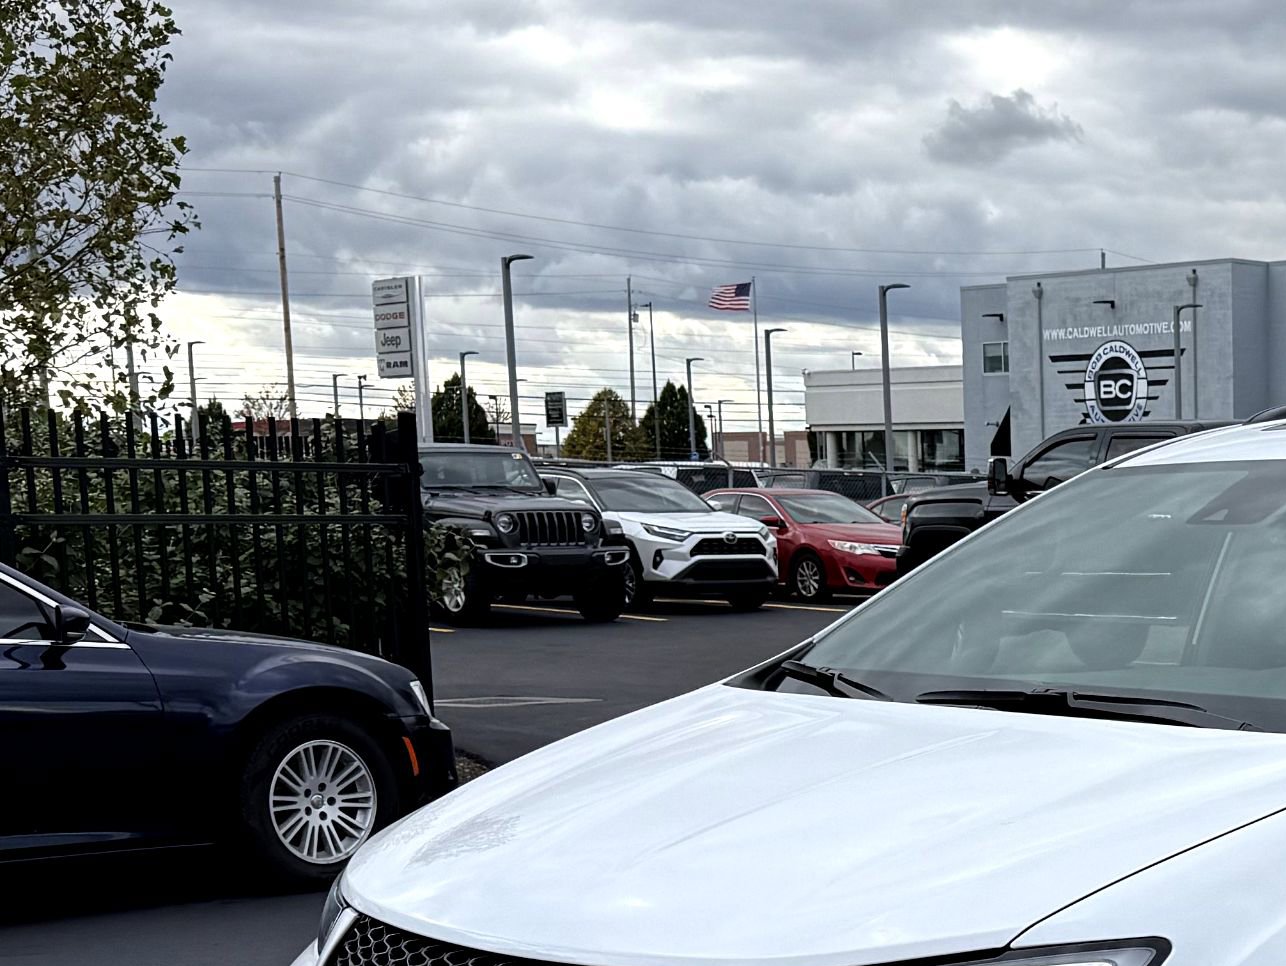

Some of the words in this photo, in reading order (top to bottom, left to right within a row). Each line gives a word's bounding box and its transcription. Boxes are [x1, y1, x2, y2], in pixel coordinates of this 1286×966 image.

[375, 311, 405, 321] DODGE
[381, 332, 402, 349] Jeep
[385, 360, 409, 369] RAM
[1087, 353, 1103, 379] BOB
[1102, 345, 1142, 376] CALDWELL
[1100, 379, 1132, 399] BC
